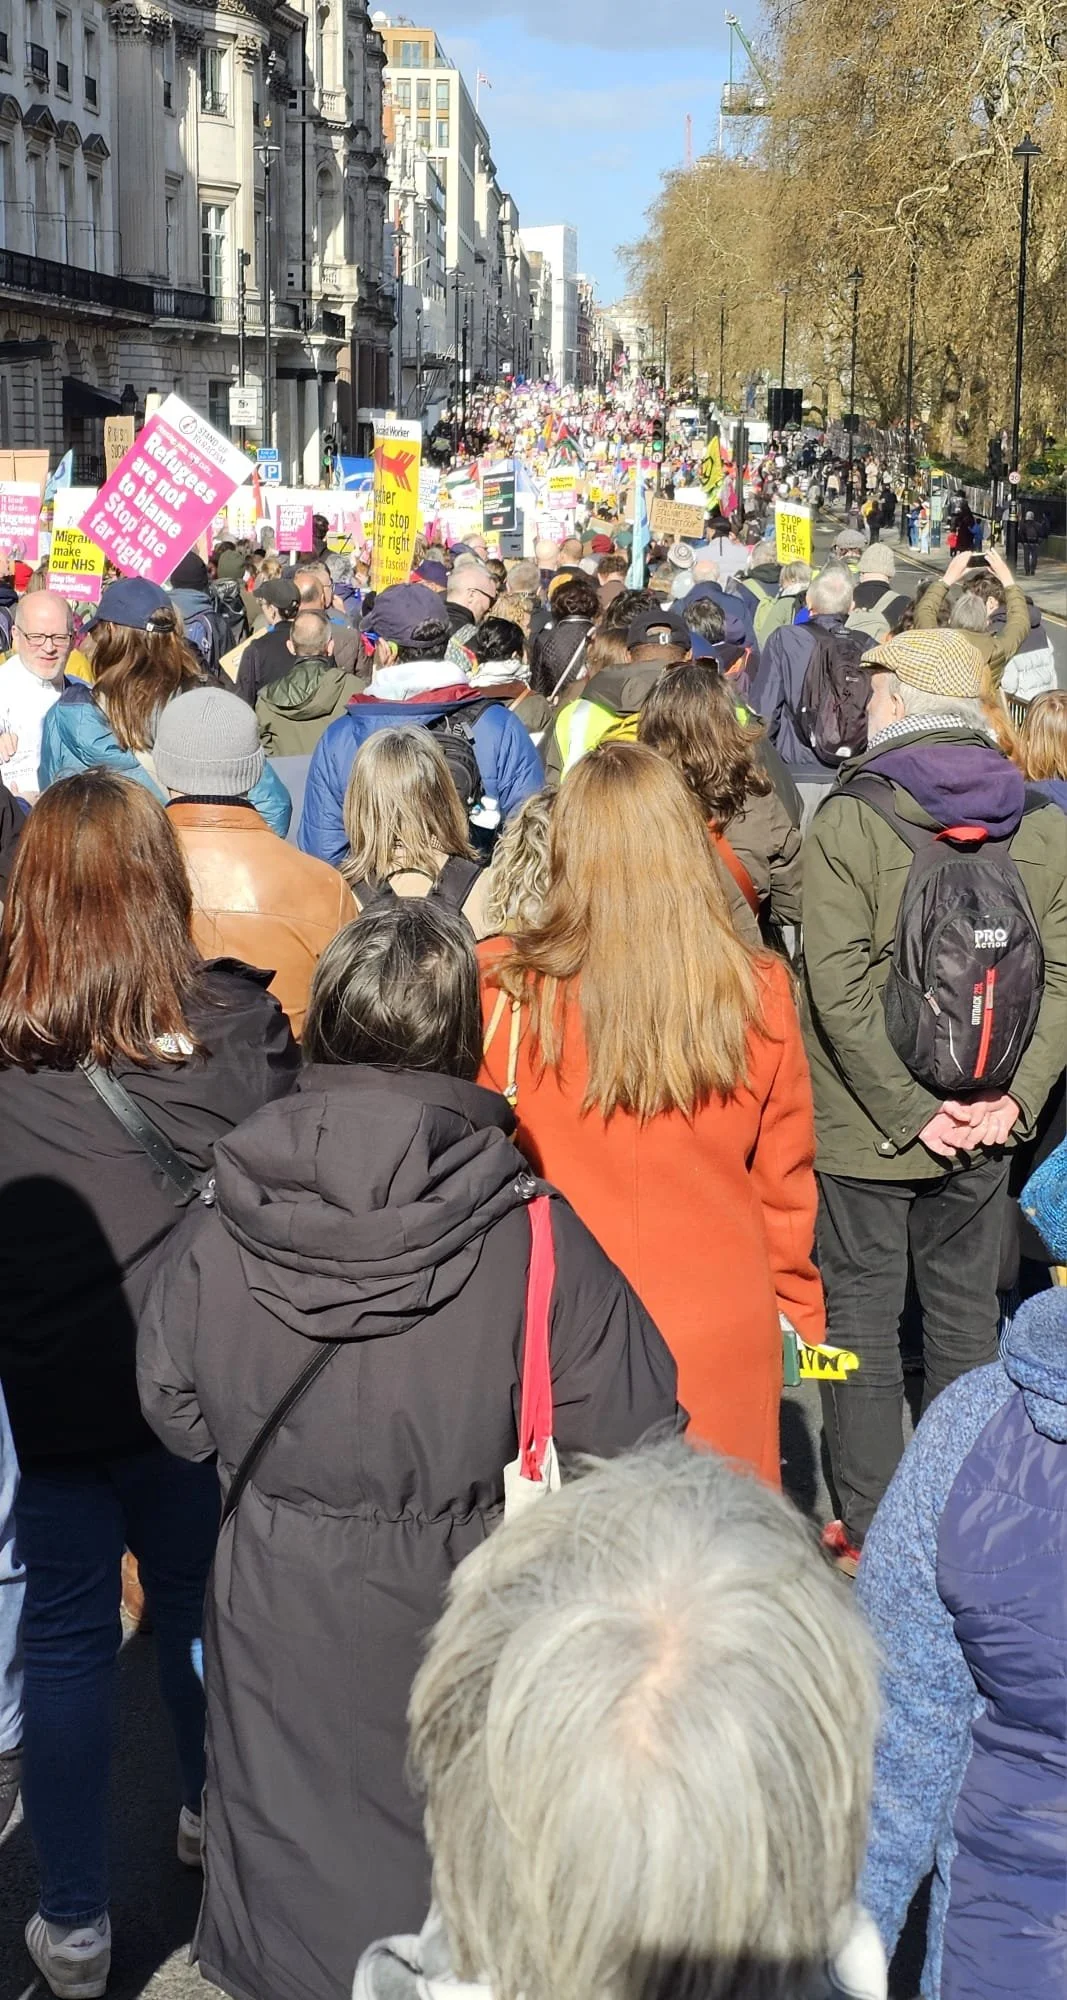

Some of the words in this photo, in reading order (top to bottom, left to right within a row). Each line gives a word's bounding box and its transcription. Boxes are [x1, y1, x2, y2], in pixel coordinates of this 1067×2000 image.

[198, 427, 219, 446] STAND
[389, 425, 410, 438] Worker
[144, 431, 217, 505] Refugees
[267, 466, 277, 478] P
[131, 456, 157, 485] are
[154, 478, 187, 511] not
[118, 472, 136, 497] to
[133, 486, 182, 539] blame
[104, 492, 139, 533] Stop
[137, 523, 167, 558] the
[389, 510, 410, 532] stop
[780, 513, 802, 526] STOP
[781, 523, 797, 534] THE
[89, 511, 115, 541] far
[111, 536, 153, 577] right
[388, 531, 410, 555] right
[781, 533, 797, 544] FAR
[54, 545, 81, 557] make
[782, 543, 805, 556] RIGHT
[52, 561, 69, 570] our
[71, 559, 95, 572] NHS
[974, 928, 1008, 943] PRO
[975, 941, 1008, 949] ACTION
[971, 995, 983, 1026] OUTBACK
